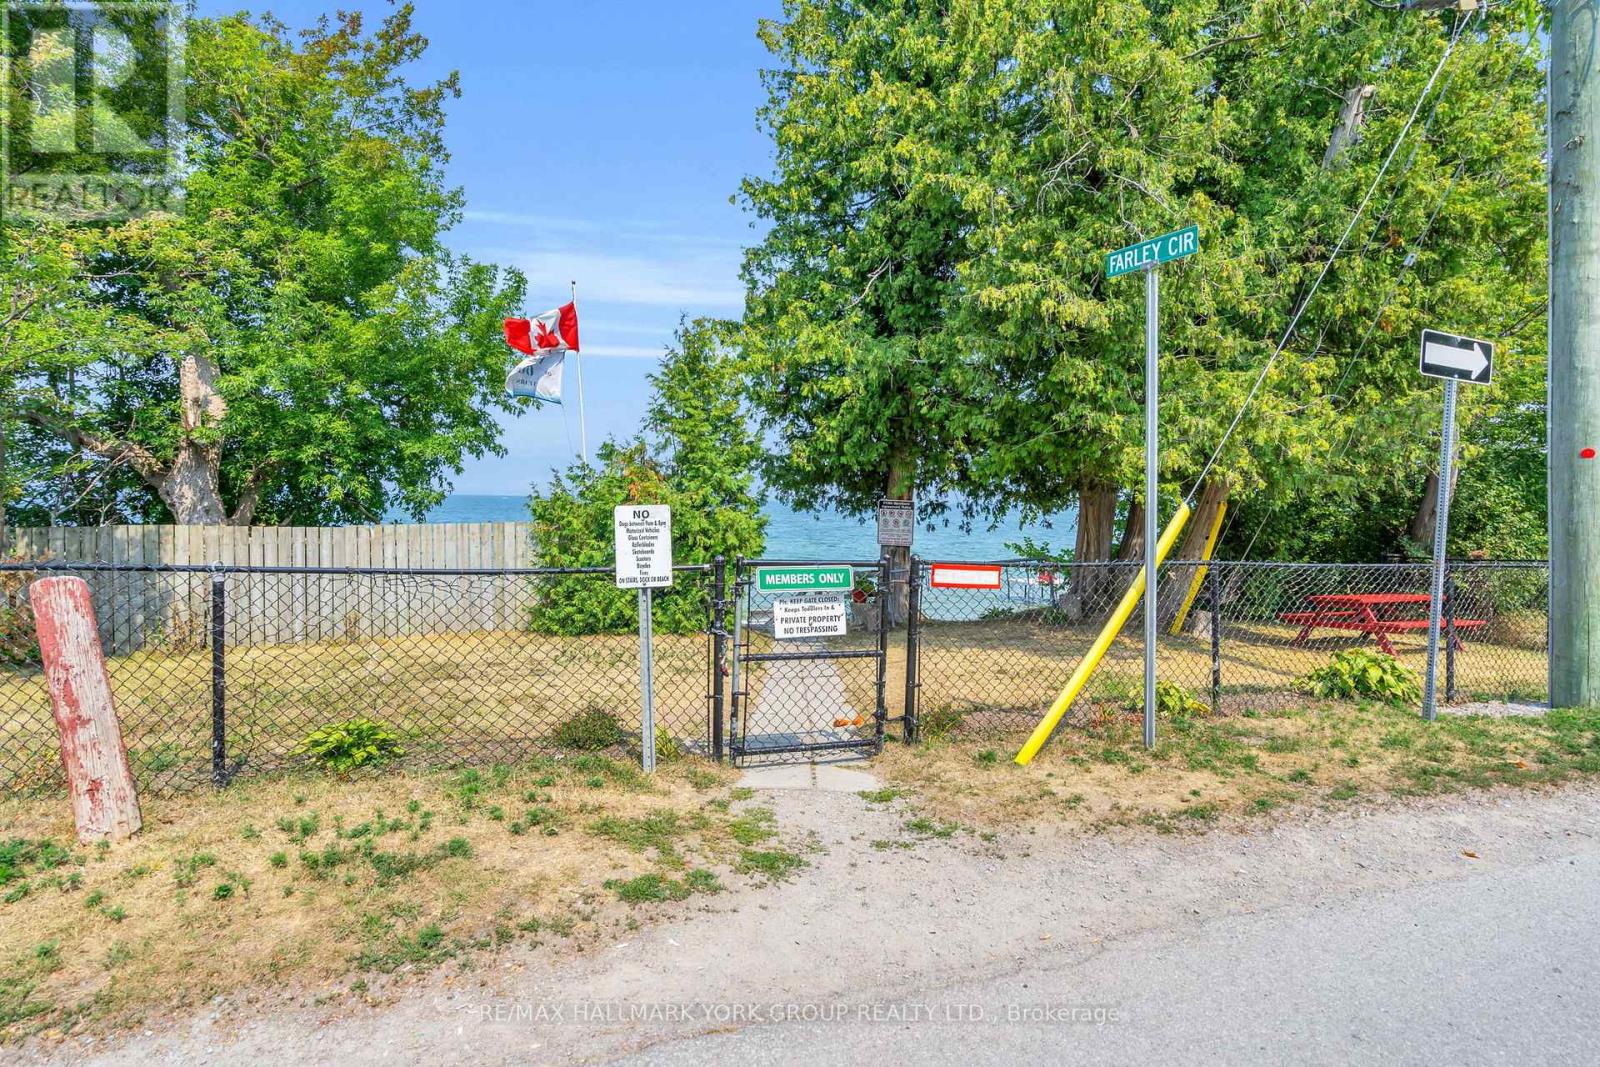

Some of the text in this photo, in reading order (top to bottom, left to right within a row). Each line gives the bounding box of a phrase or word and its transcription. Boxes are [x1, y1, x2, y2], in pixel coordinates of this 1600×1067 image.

[1109, 232, 1194, 274] FARLEY CIR
[633, 510, 650, 519] NO
[766, 573, 845, 585] MEMBERS ONLY
[781, 615, 841, 625] PRIVATE PROPERTY
[784, 625, 838, 635] NO TRESPASSING
